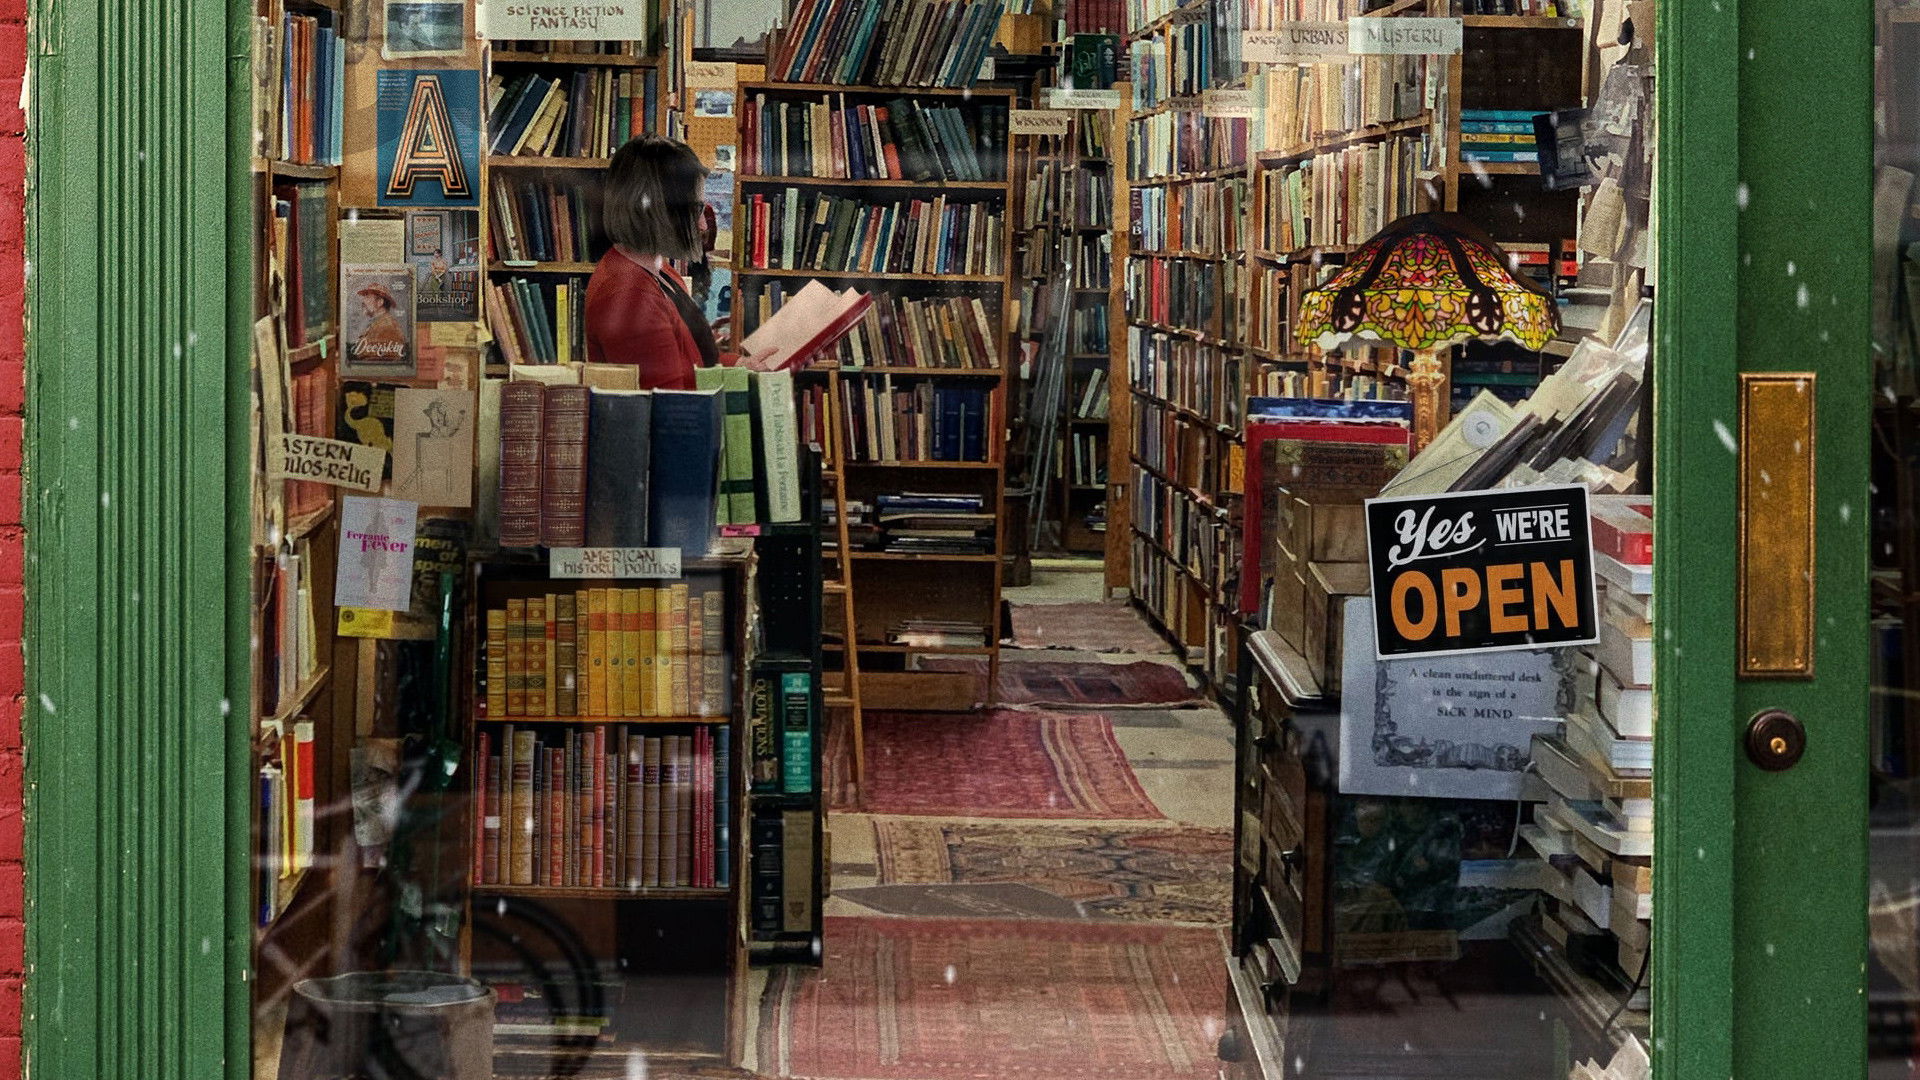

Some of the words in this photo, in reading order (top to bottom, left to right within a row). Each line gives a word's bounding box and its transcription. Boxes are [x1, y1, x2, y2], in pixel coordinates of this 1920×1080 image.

[506, 6, 567, 17] SCIENCE
[573, 6, 625, 17] FICTION
[530, 16, 598, 32] FANTASY
[1290, 28, 1334, 45] URBAN
[1367, 27, 1444, 48] MYSTERY
[385, 75, 471, 198] A
[416, 294, 469, 305] Bookshop
[346, 531, 390, 542] Ferrante
[1388, 506, 1486, 572] Yes
[1495, 509, 1571, 541] WE'RE
[361, 540, 408, 552] Fever
[583, 550, 656, 562] AMERICAN
[624, 563, 678, 577] POLITICS
[1390, 559, 1579, 641] OPEN
[1409, 670, 1418, 678] A
[1422, 669, 1451, 679] clean
[1455, 670, 1516, 682] uncluttered
[1518, 671, 1542, 683] desk
[1432, 688, 1441, 697] is
[1446, 687, 1463, 698] the
[1468, 688, 1491, 699] sign
[1495, 688, 1507, 698] of
[1510, 691, 1516, 699] a
[1436, 706, 1469, 717] SICK
[1473, 707, 1513, 719] MIND
